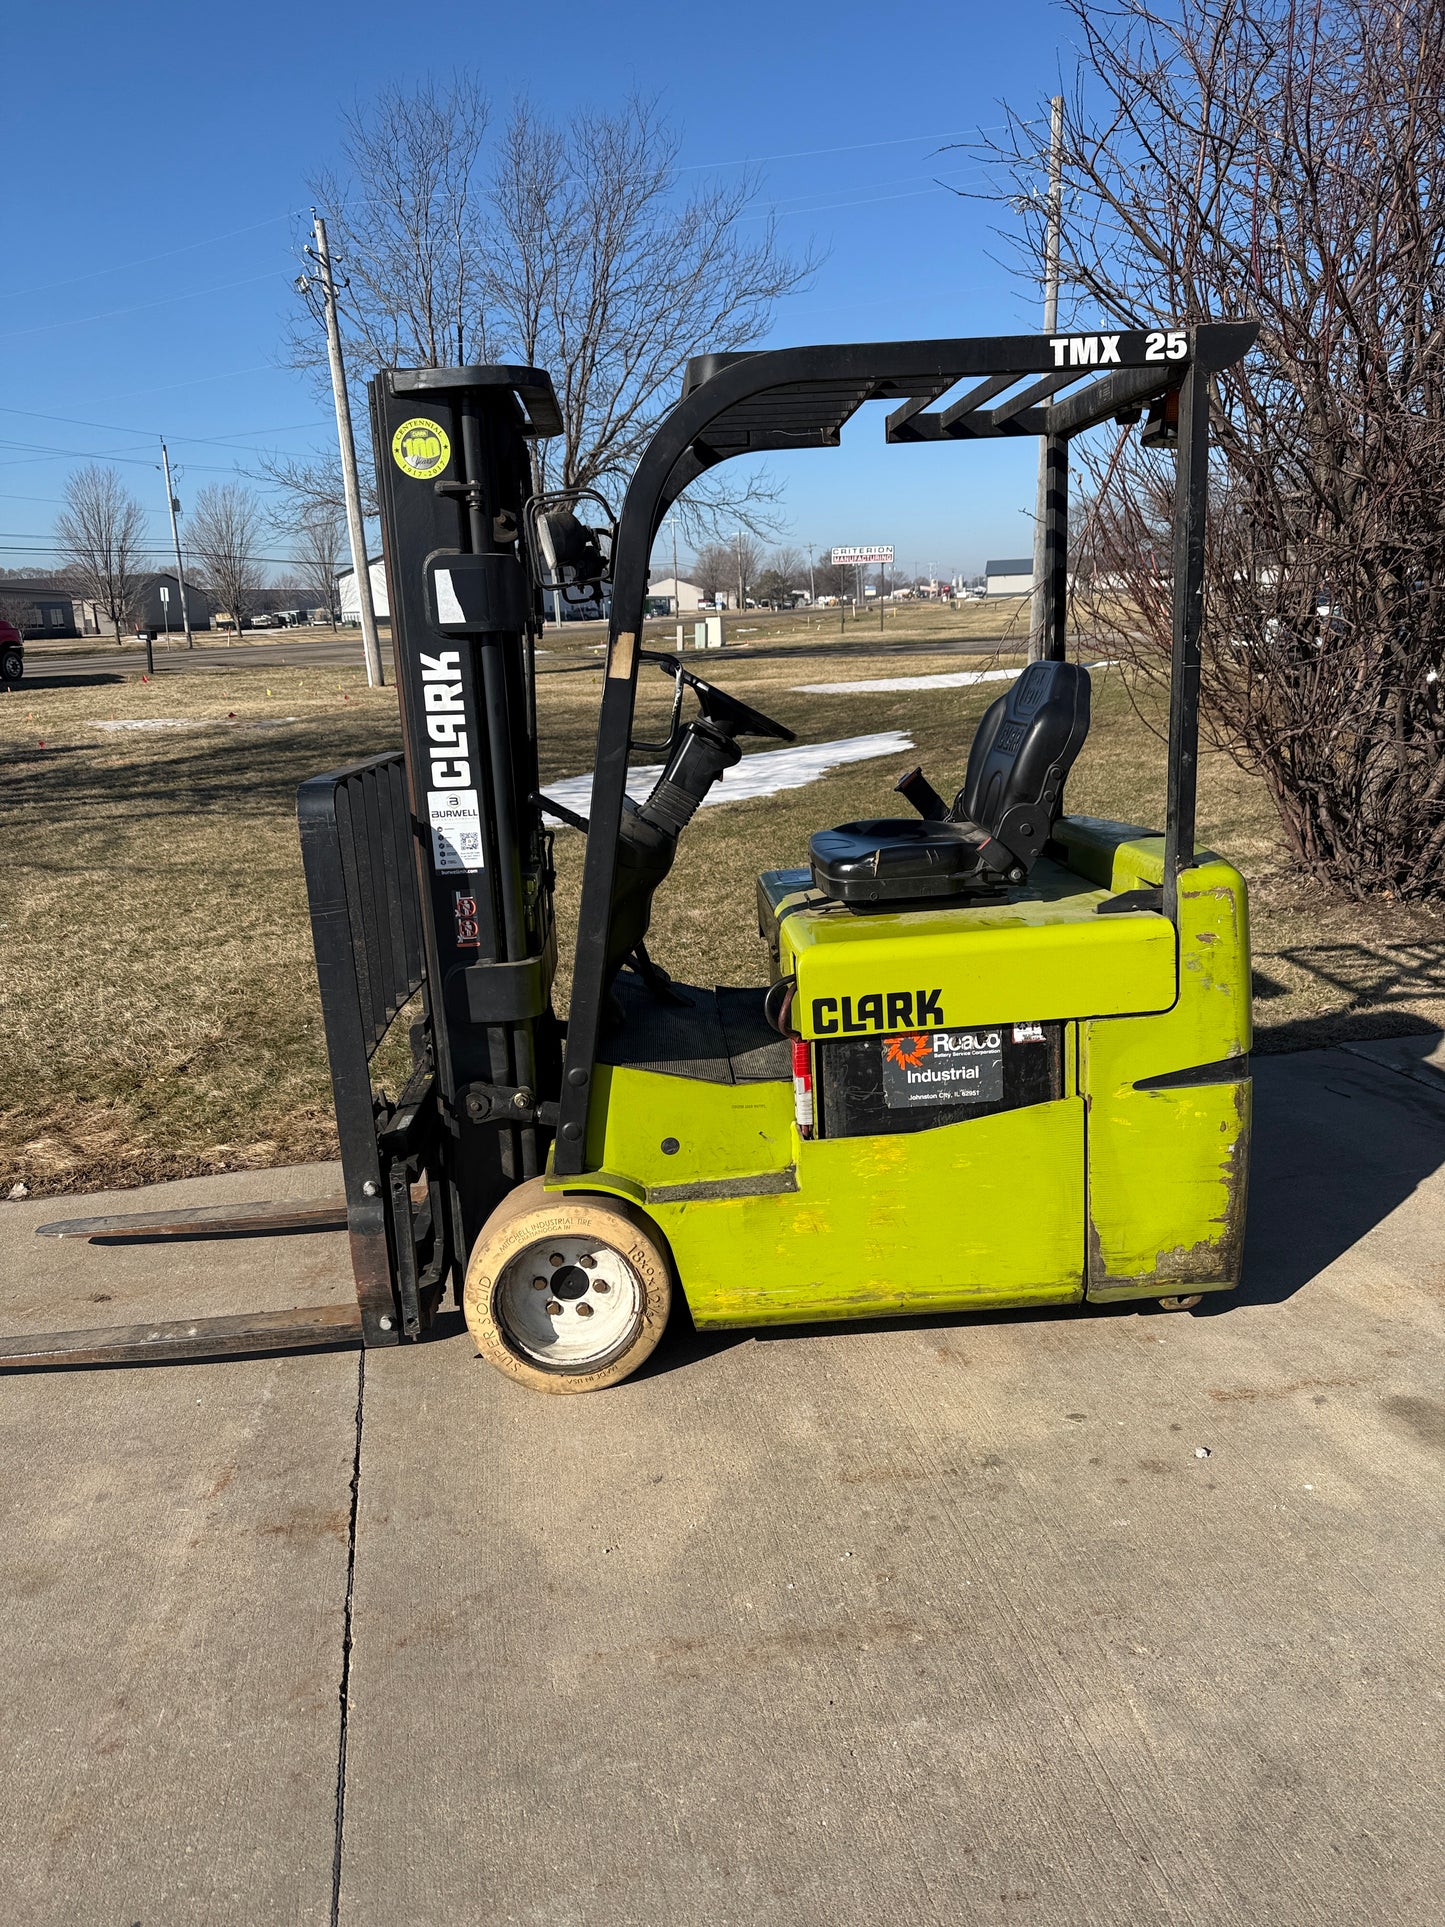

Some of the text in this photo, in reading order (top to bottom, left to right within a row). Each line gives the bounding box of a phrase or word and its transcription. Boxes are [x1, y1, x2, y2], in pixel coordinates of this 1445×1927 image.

[1050, 331, 1188, 366] TMX 25
[396, 420, 442, 441] CENTENNIAL
[833, 547, 892, 555] CRITERION
[833, 554, 892, 562] MANUFACTURING
[420, 651, 471, 788] CLARK
[431, 809, 478, 818] BURWELL
[812, 989, 944, 1034] CLARK
[907, 1066, 979, 1082] Industrial
[908, 1093, 938, 1101] Johnston
[500, 1226, 531, 1252] MITCHELL
[531, 1217, 574, 1232] INDUSTRIAL
[476, 1276, 522, 1372] SUPER SOLID
